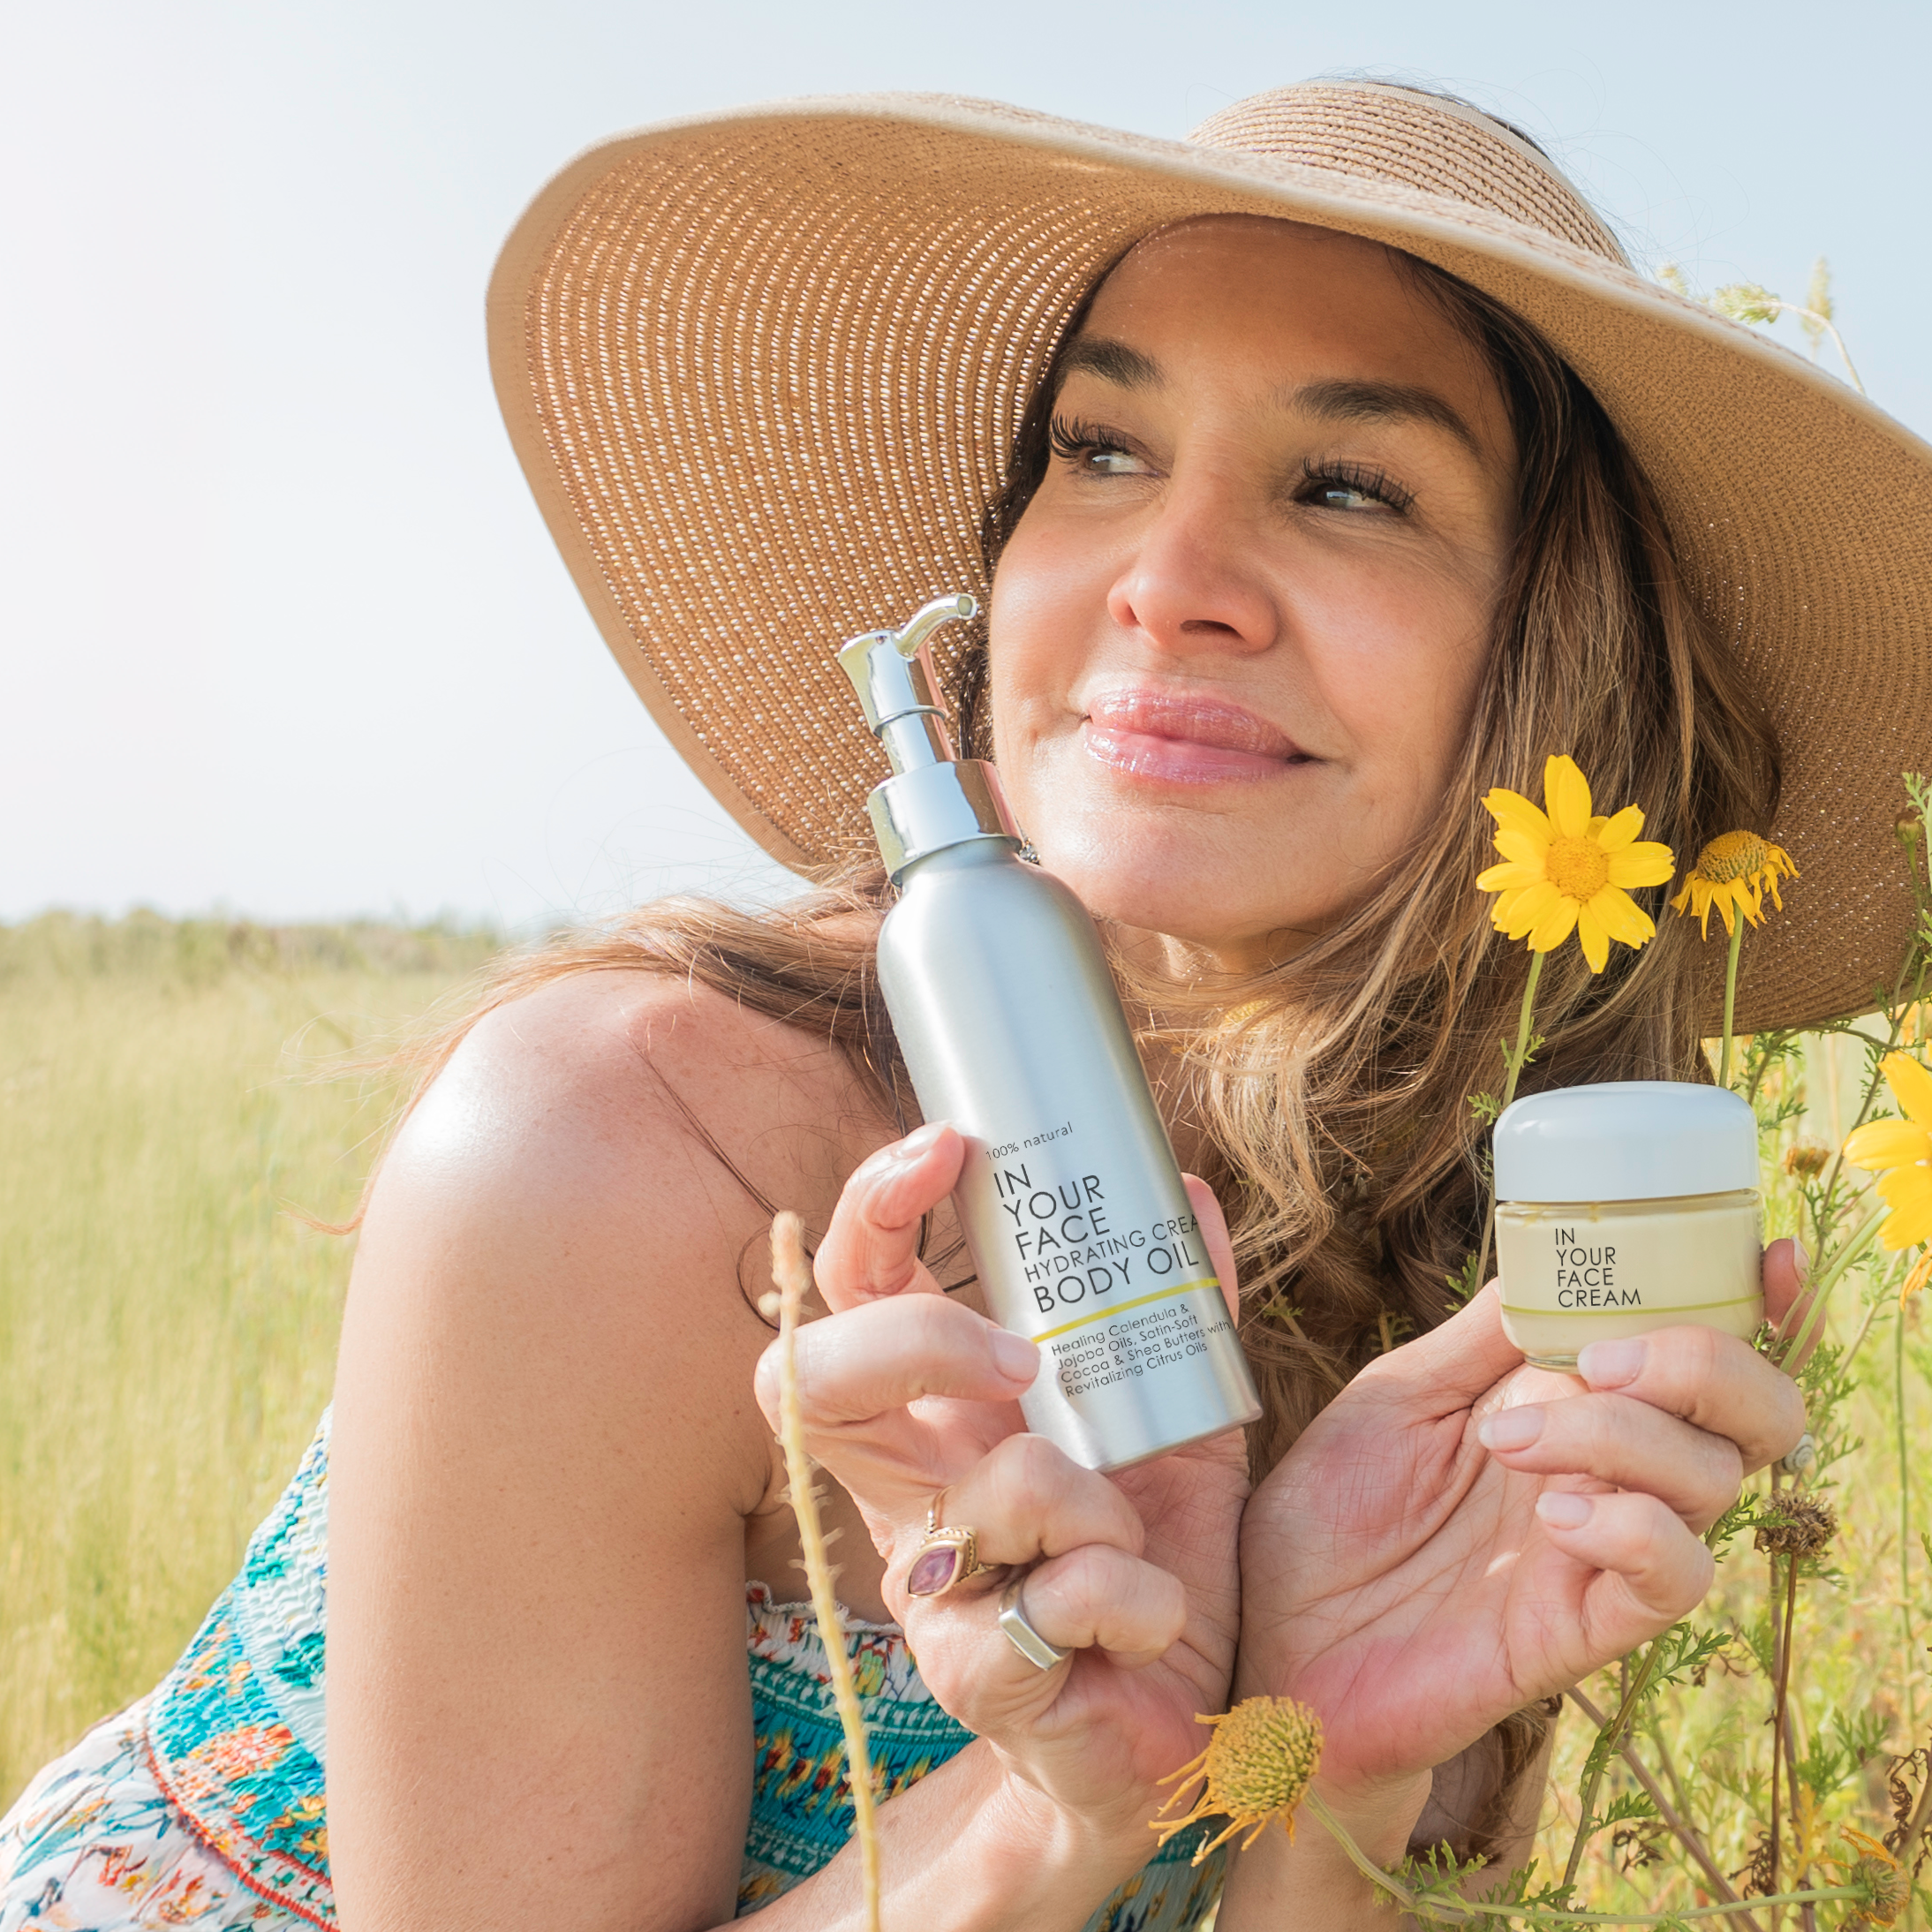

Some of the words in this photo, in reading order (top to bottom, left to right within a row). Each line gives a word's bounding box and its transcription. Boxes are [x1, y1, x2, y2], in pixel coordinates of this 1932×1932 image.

[985, 1142, 1019, 1161] 100%
[1023, 1121, 1073, 1149] natural
[993, 1164, 1031, 1198] IN
[1003, 1174, 1105, 1227] YOUR
[1015, 1207, 1110, 1260] FACE
[1024, 1230, 1145, 1283] HYDRATING
[1555, 1227, 1574, 1245] IN
[1556, 1247, 1616, 1266] YOUR
[1034, 1257, 1130, 1313] BODY
[1147, 1241, 1199, 1275] OIL
[1558, 1268, 1614, 1287] FACE
[1558, 1288, 1641, 1308] CREAM
[1051, 1330, 1106, 1355] Healing
[1108, 1308, 1177, 1337] Calendula
[1180, 1303, 1189, 1313] &
[1058, 1347, 1105, 1370] Jojoba
[1108, 1338, 1137, 1353] Oils,
[1140, 1315, 1198, 1341] Satin-Soft
[1060, 1360, 1110, 1384] Cocoa
[1114, 1355, 1125, 1366] &
[1128, 1346, 1161, 1361] Shea
[1165, 1329, 1206, 1348] Butters
[1207, 1321, 1231, 1334] with
[1065, 1362, 1143, 1398] Revitalizing
[1146, 1349, 1183, 1370] Citrus
[1186, 1342, 1208, 1355] Oils
